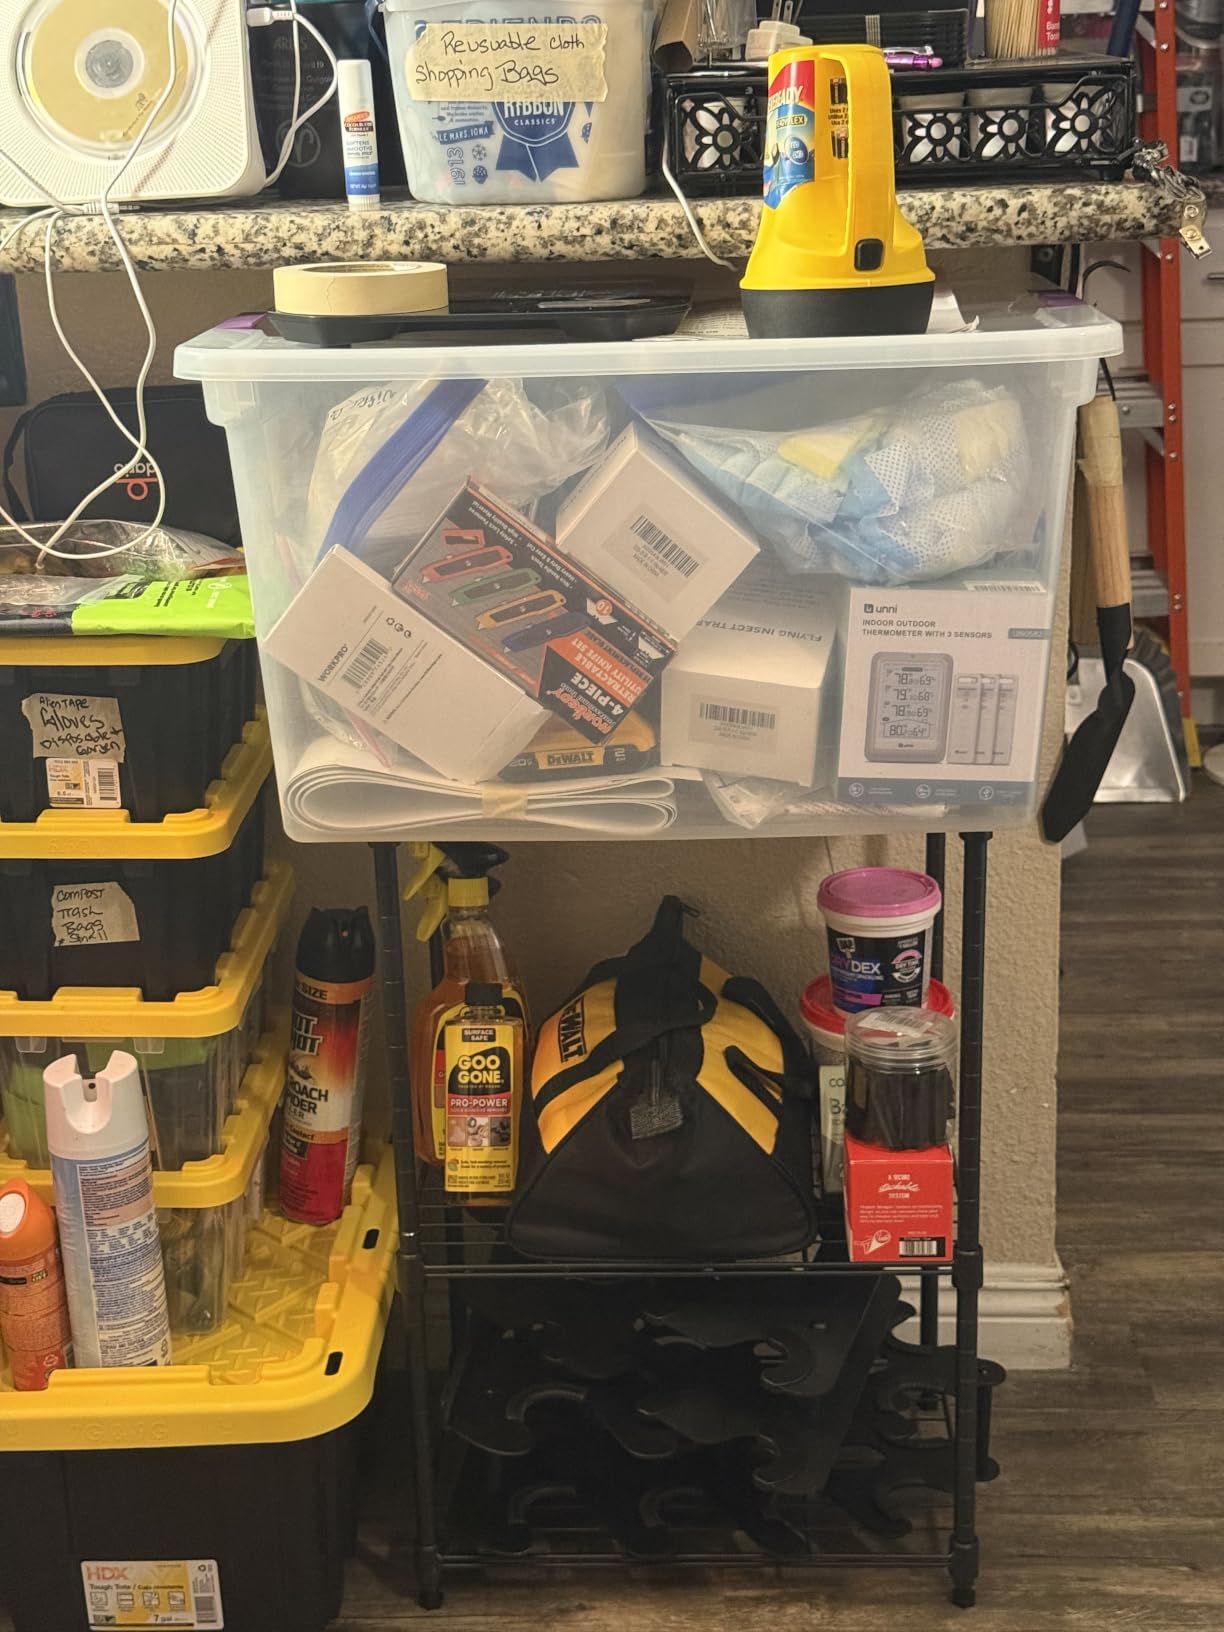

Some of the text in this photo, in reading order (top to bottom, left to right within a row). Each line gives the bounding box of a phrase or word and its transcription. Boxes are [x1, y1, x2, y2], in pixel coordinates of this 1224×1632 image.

[415, 59, 559, 91] Shopping Bags
[514, 118, 556, 126] CLASSICS
[471, 126, 489, 137] IOWA
[447, 146, 466, 185] 1913
[876, 604, 898, 614] unni
[727, 623, 775, 637] INSECT
[863, 619, 936, 628] INDOOR OUTDOOR
[779, 629, 823, 642] FLYING
[863, 629, 923, 637] THERMOMETER
[925, 630, 945, 638] WITH
[954, 631, 992, 639] SENSORS
[570, 637, 643, 695] UTILITY KNIFE SET
[573, 652, 637, 703] RETRACTABLE
[569, 671, 625, 717] 4-PIECE
[40, 707, 104, 731] Gloves
[302, 983, 328, 1001] SIZE
[458, 1055, 500, 1070] GOO
[458, 1071, 502, 1084] GONE
[450, 1098, 508, 1107] PRO-POWER
[86, 1566, 129, 1580] HDX
